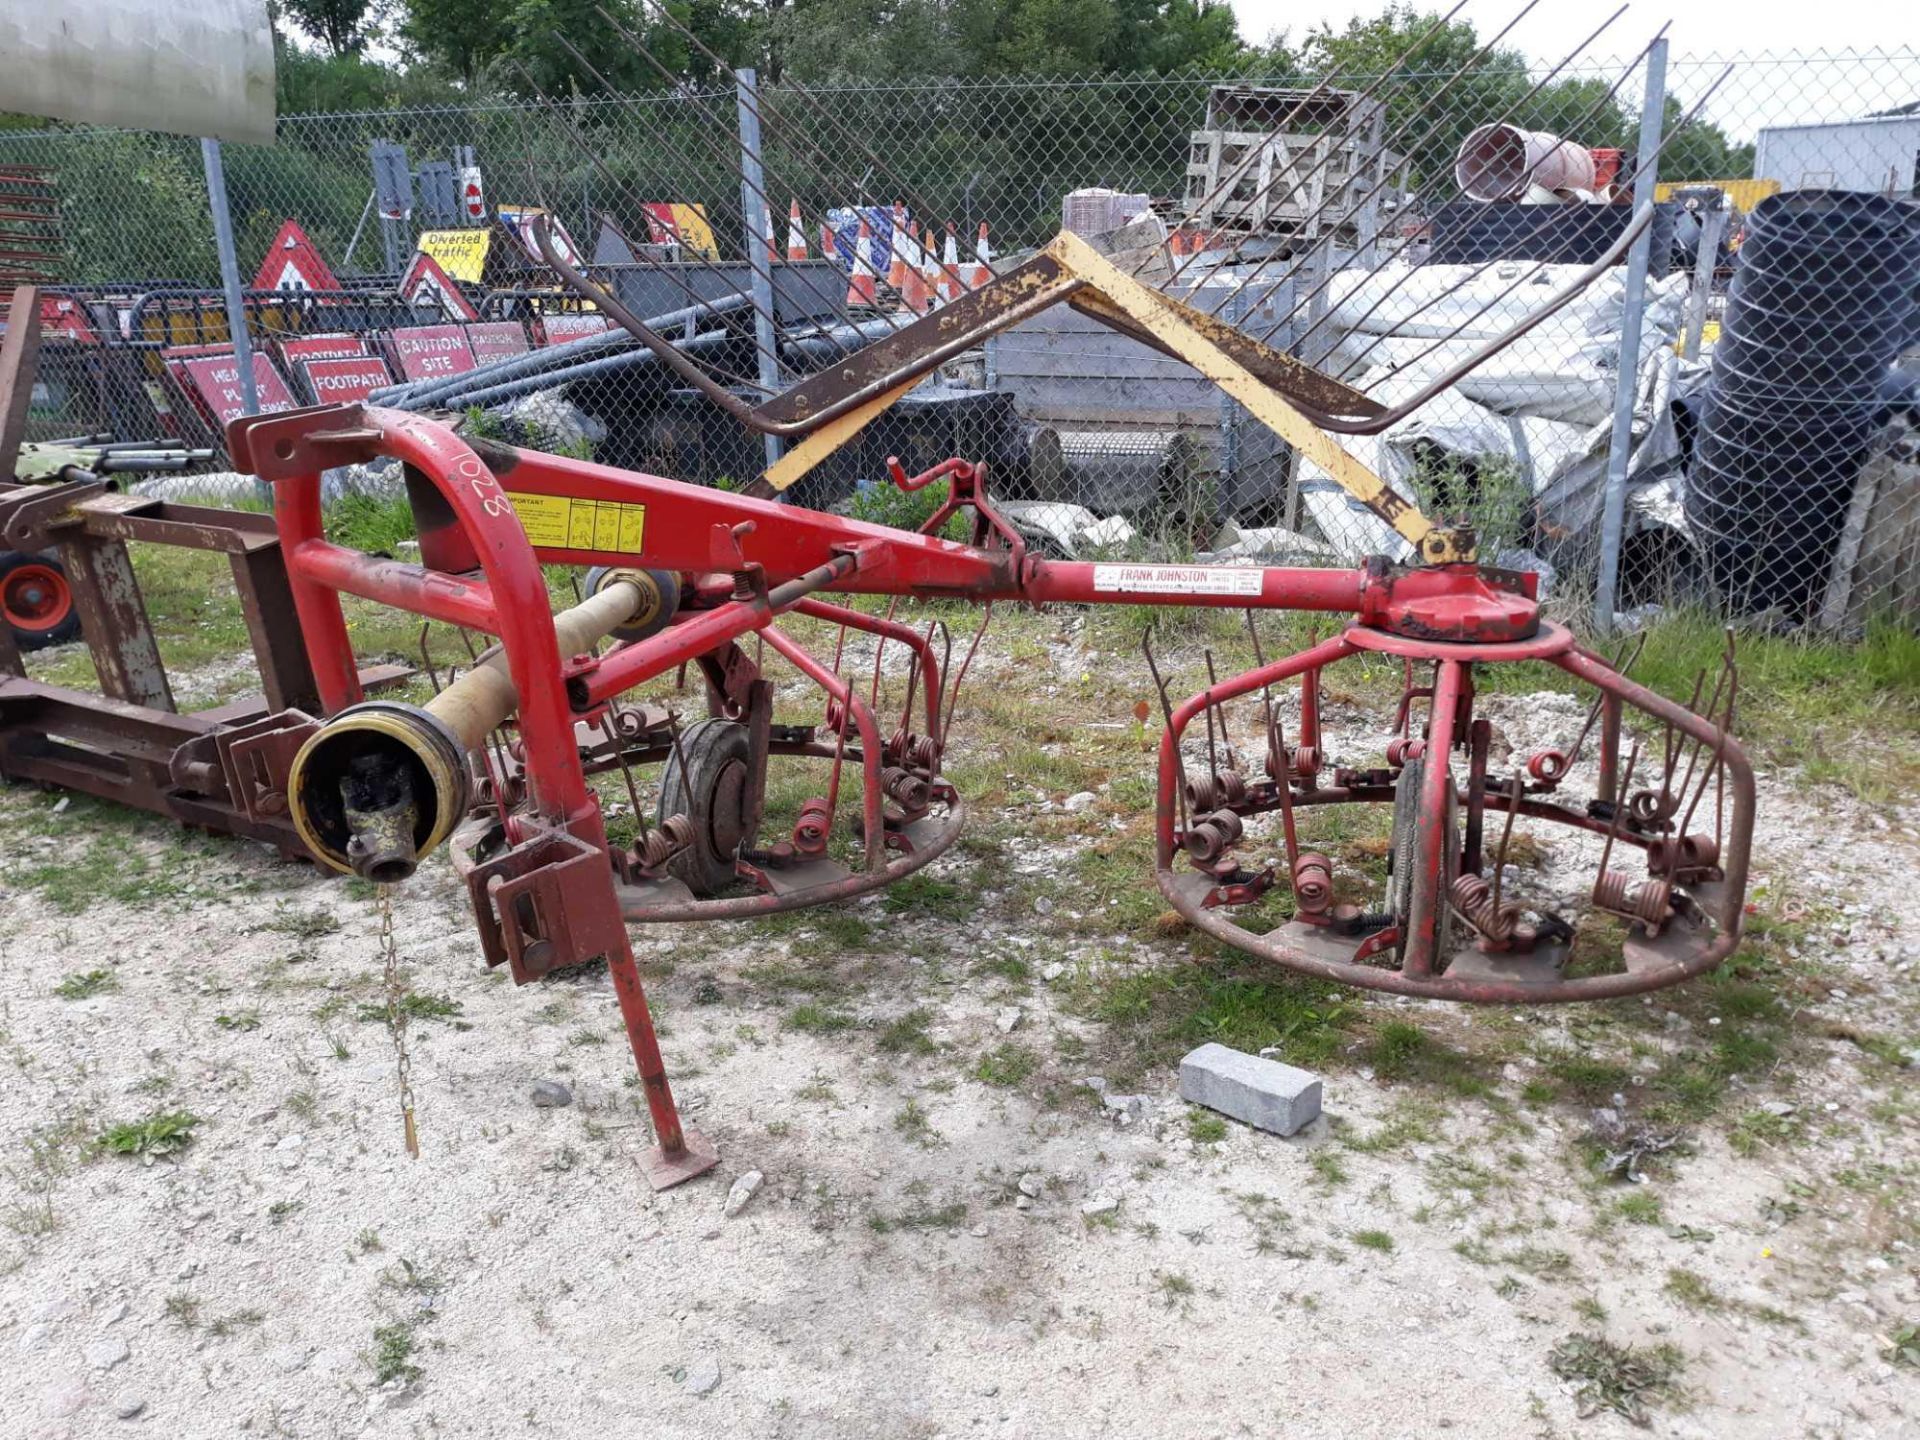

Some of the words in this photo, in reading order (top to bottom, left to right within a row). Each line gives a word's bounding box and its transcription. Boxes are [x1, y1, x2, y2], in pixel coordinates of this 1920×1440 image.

[429, 233, 480, 244] Diverted
[432, 245, 472, 257] traffic
[401, 335, 463, 355] CAUTION
[421, 356, 454, 372] SITE
[315, 373, 387, 391] FOOTPATH
[450, 451, 512, 518] 1028
[1120, 568, 1153, 581] FRANK
[1156, 569, 1208, 583] JOHNSTON
